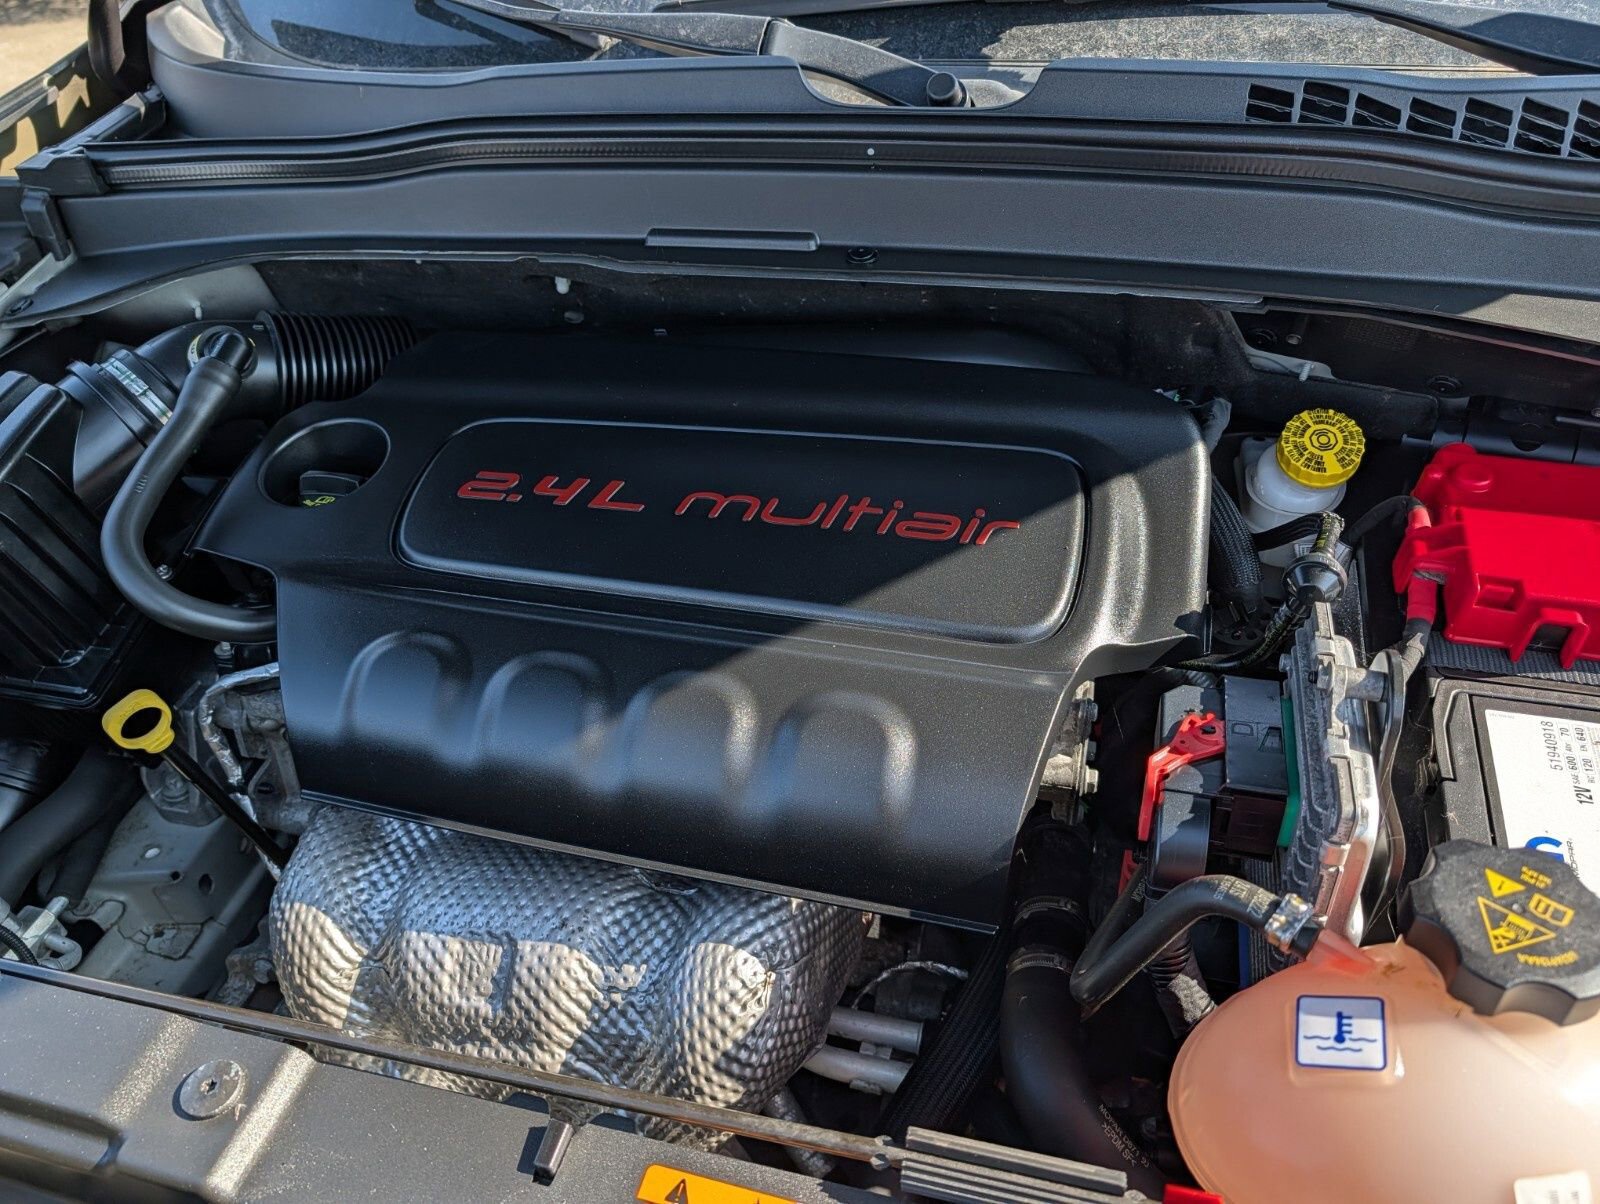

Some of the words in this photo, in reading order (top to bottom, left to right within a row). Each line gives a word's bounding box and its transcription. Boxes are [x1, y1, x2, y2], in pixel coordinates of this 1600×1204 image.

[457, 470, 645, 513] 2.4L
[673, 491, 1021, 546] multiair
[1560, 727, 1570, 737] 70
[1574, 727, 1586, 742] 640
[1541, 720, 1563, 771] 51940918
[1566, 756, 1578, 771] 600
[1582, 758, 1594, 773] 120
[1573, 785, 1594, 805] 12V
